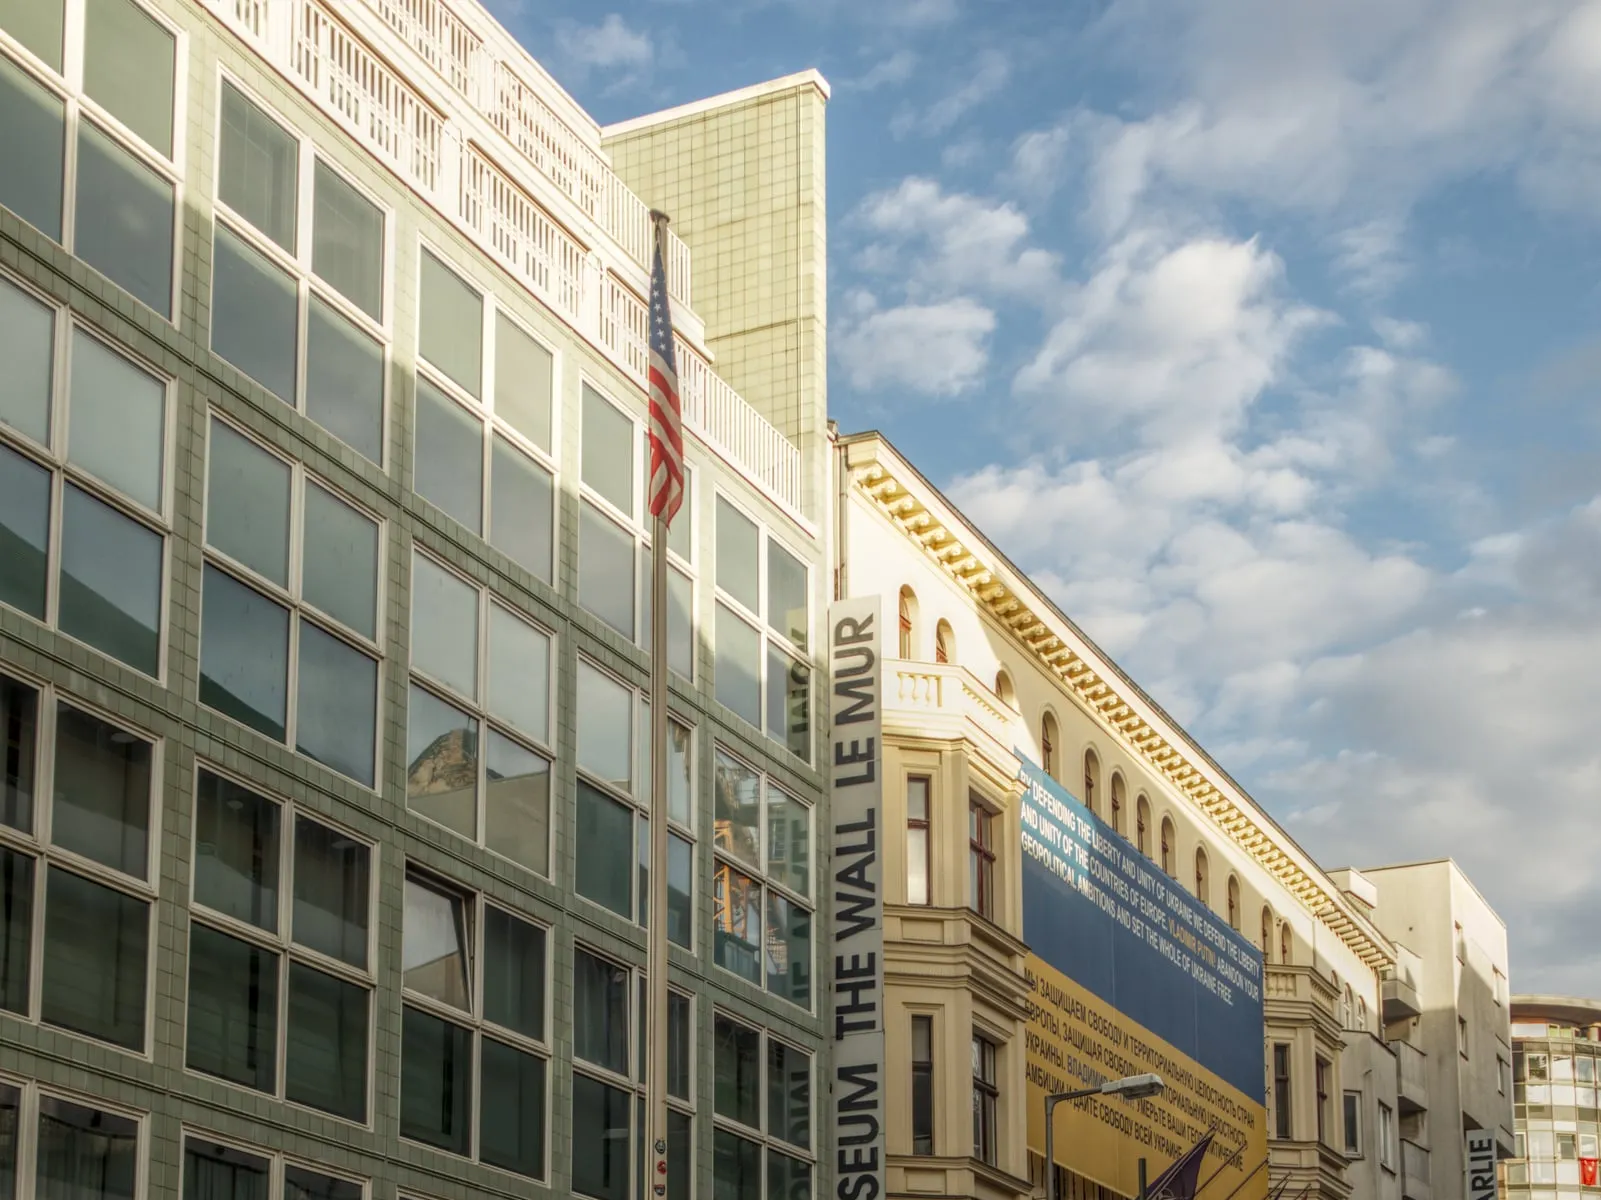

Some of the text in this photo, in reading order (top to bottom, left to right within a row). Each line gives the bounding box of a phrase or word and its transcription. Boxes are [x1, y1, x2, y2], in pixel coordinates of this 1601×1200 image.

[834, 612, 875, 726] MUR
[835, 737, 875, 788] LE
[836, 808, 876, 942] WALL
[1021, 801, 1038, 829] AND
[1039, 816, 1063, 848] UNITY
[1063, 835, 1074, 857] OF
[1074, 842, 1089, 871] THE
[1089, 856, 1129, 902] COUNTRIES
[1130, 886, 1139, 908] OF
[1140, 896, 1168, 931] EUROPE.
[1168, 916, 1196, 953] VLADIMIR
[1217, 956, 1244, 990] ABANDON
[1243, 978, 1259, 1002] YOUR
[1021, 831, 1077, 890] GEOPOLITICAL
[1077, 874, 1115, 918] AMBITIONS
[1116, 904, 1131, 930] AND
[1132, 916, 1145, 940] SET
[1145, 925, 1158, 950] THE
[1159, 935, 1181, 968] WHOLE
[1181, 953, 1191, 973] OF
[1192, 961, 1217, 994] UKRAINE
[1033, 781, 1076, 831] DEFENDING
[1076, 817, 1091, 843] THE
[1092, 829, 1120, 867] LIBERTY
[1121, 854, 1136, 880] AND
[1137, 867, 1156, 895] UNITY
[1156, 882, 1165, 902] OF
[1166, 890, 1192, 926] UKRAINE
[1192, 911, 1203, 934] WE
[1203, 920, 1226, 952] DEFEND
[1227, 938, 1238, 961] THE
[1238, 948, 1260, 978] LIBERTY
[836, 952, 876, 1041] THE
[1063, 1023, 1102, 1062] ЗАЩИЩАЯ
[1025, 1028, 1066, 1070] УКРАИНЫ.
[1167, 1113, 1186, 1139] ВАШИ
[1026, 1060, 1065, 1096] АМБИЦИИ
[1100, 1103, 1133, 1138] СВОБОДУ
[1134, 1120, 1152, 1146] ВСЕЙ
[1040, 978, 1087, 1025] ЗАЩИЩАЕМ
[1087, 1009, 1123, 1048] СВОБОДУ
[1123, 1031, 1129, 1050] И
[1129, 1036, 1193, 1090] ТЕРРИТОРИАЛЬНУЮ
[1194, 1078, 1237, 1118] ЦЕЛОСТНОСТЬ
[1237, 1105, 1255, 1130] СТРАН
